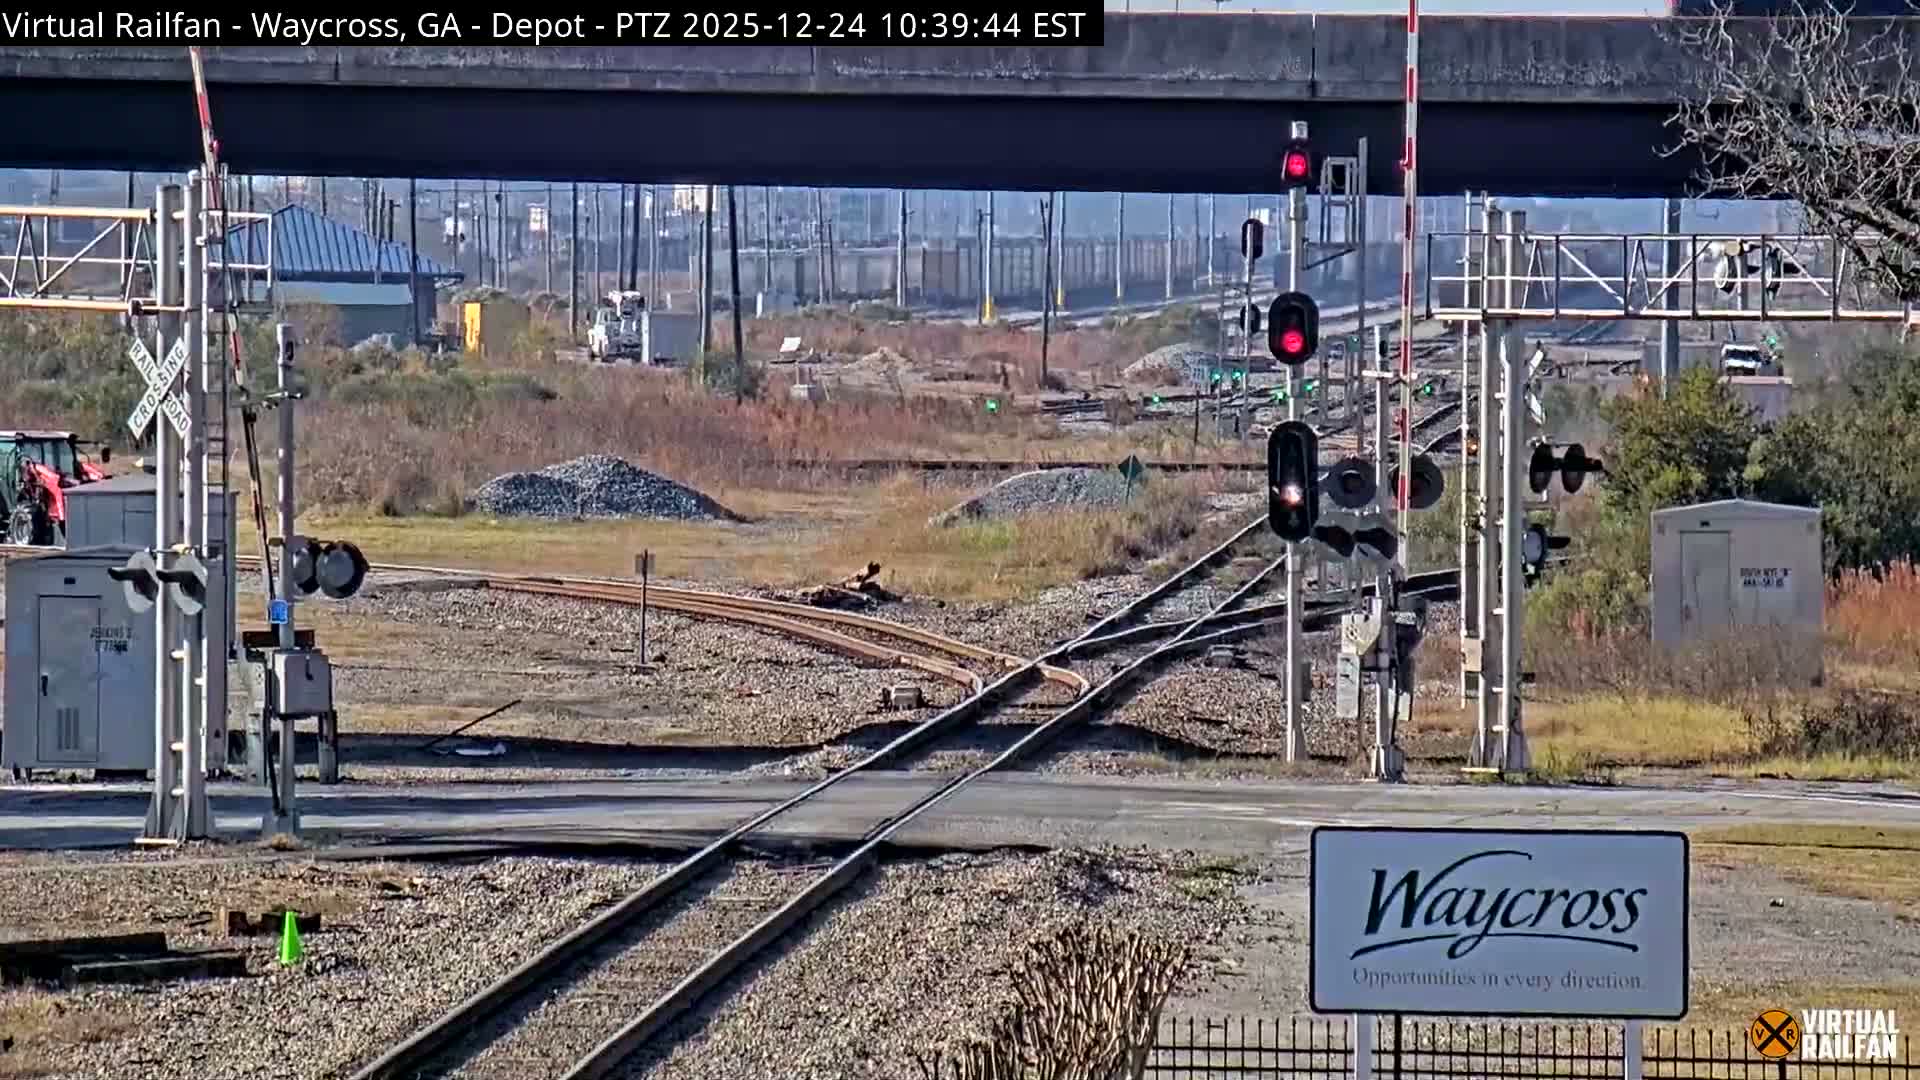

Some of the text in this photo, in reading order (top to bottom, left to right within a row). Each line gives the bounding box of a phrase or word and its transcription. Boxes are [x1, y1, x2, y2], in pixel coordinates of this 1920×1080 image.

[131, 343, 189, 432] RAIL ROAD
[132, 345, 185, 429] CROSSING
[1362, 850, 1649, 960] Waycross
[1352, 966, 1477, 987] Opportunities
[1481, 968, 1499, 987] in
[1504, 974, 1552, 992] every
